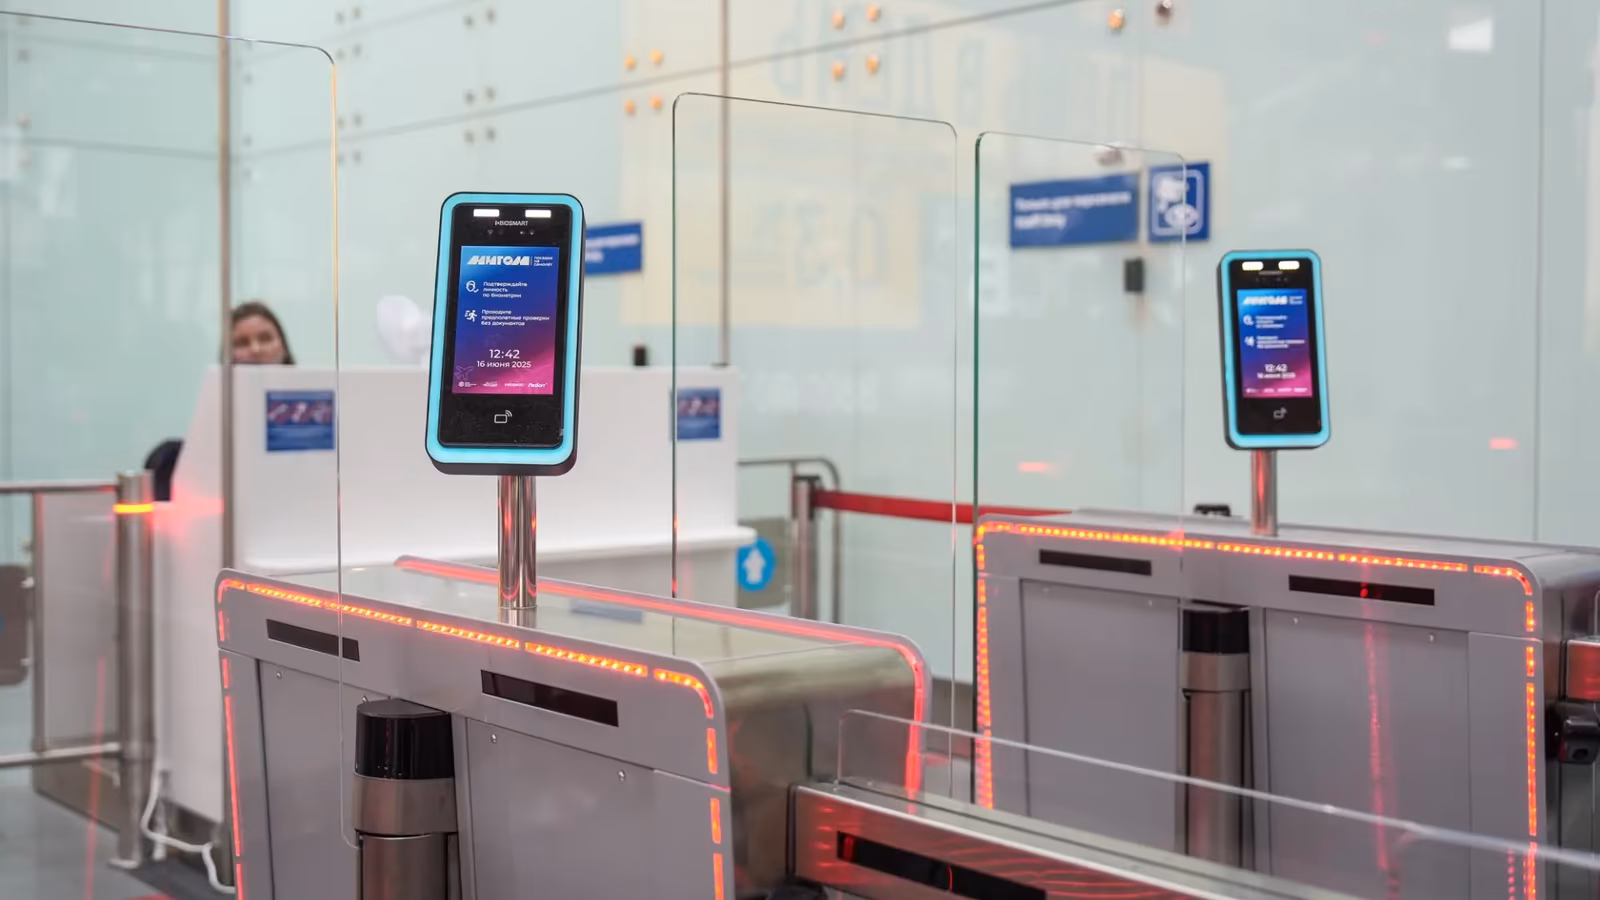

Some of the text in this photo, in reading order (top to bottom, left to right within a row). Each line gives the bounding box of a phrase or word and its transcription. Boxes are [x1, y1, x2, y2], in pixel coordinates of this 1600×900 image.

[488, 348, 520, 359] 12:42
[476, 360, 486, 368] 16
[511, 361, 532, 369] 2025
